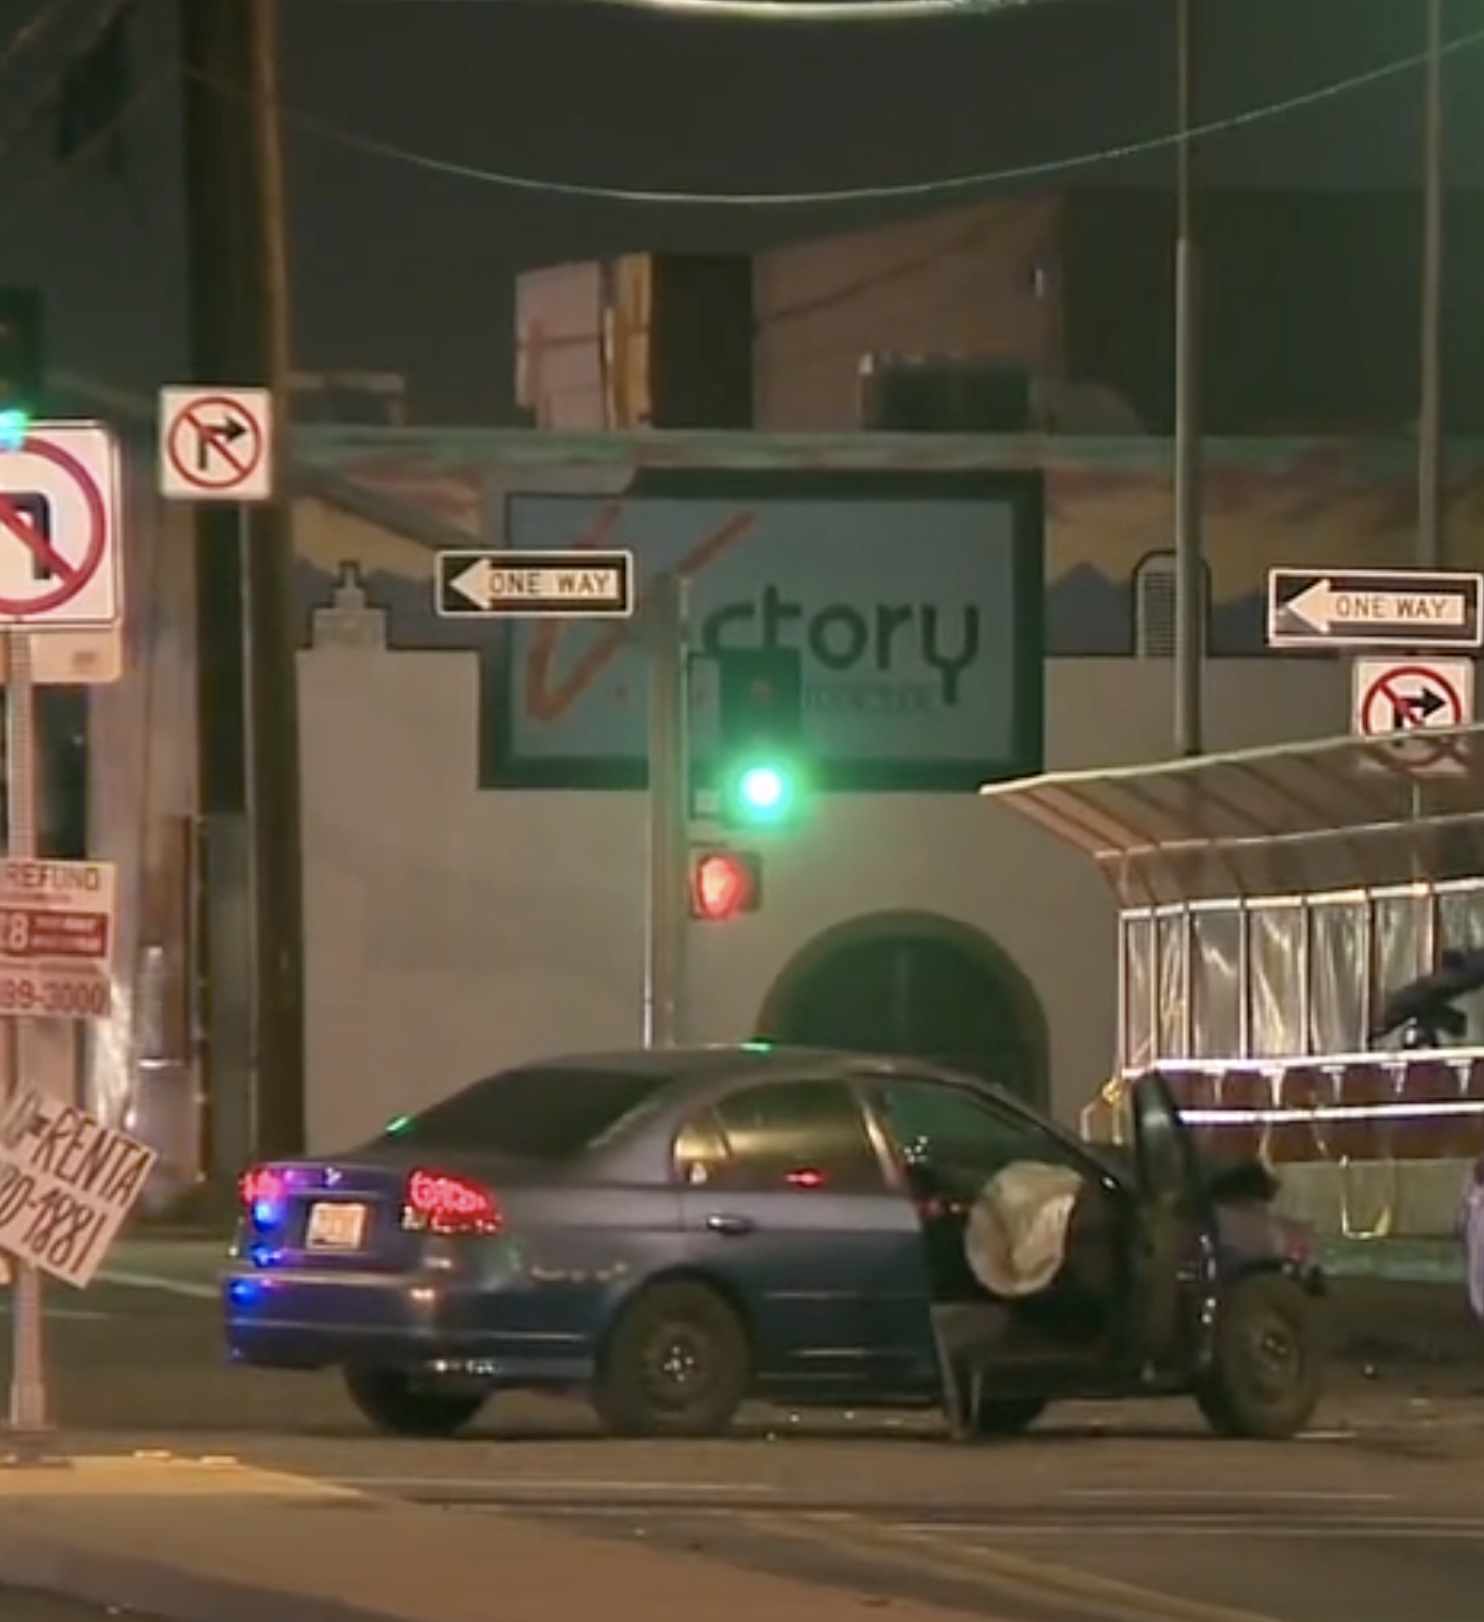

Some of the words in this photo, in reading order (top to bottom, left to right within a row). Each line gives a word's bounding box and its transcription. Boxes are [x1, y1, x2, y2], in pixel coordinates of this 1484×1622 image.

[488, 572, 541, 595] ONE
[556, 573, 611, 594] WAY
[1335, 596, 1385, 619] ONE
[1396, 597, 1448, 619] WAY
[7, 863, 99, 891] REFUND
